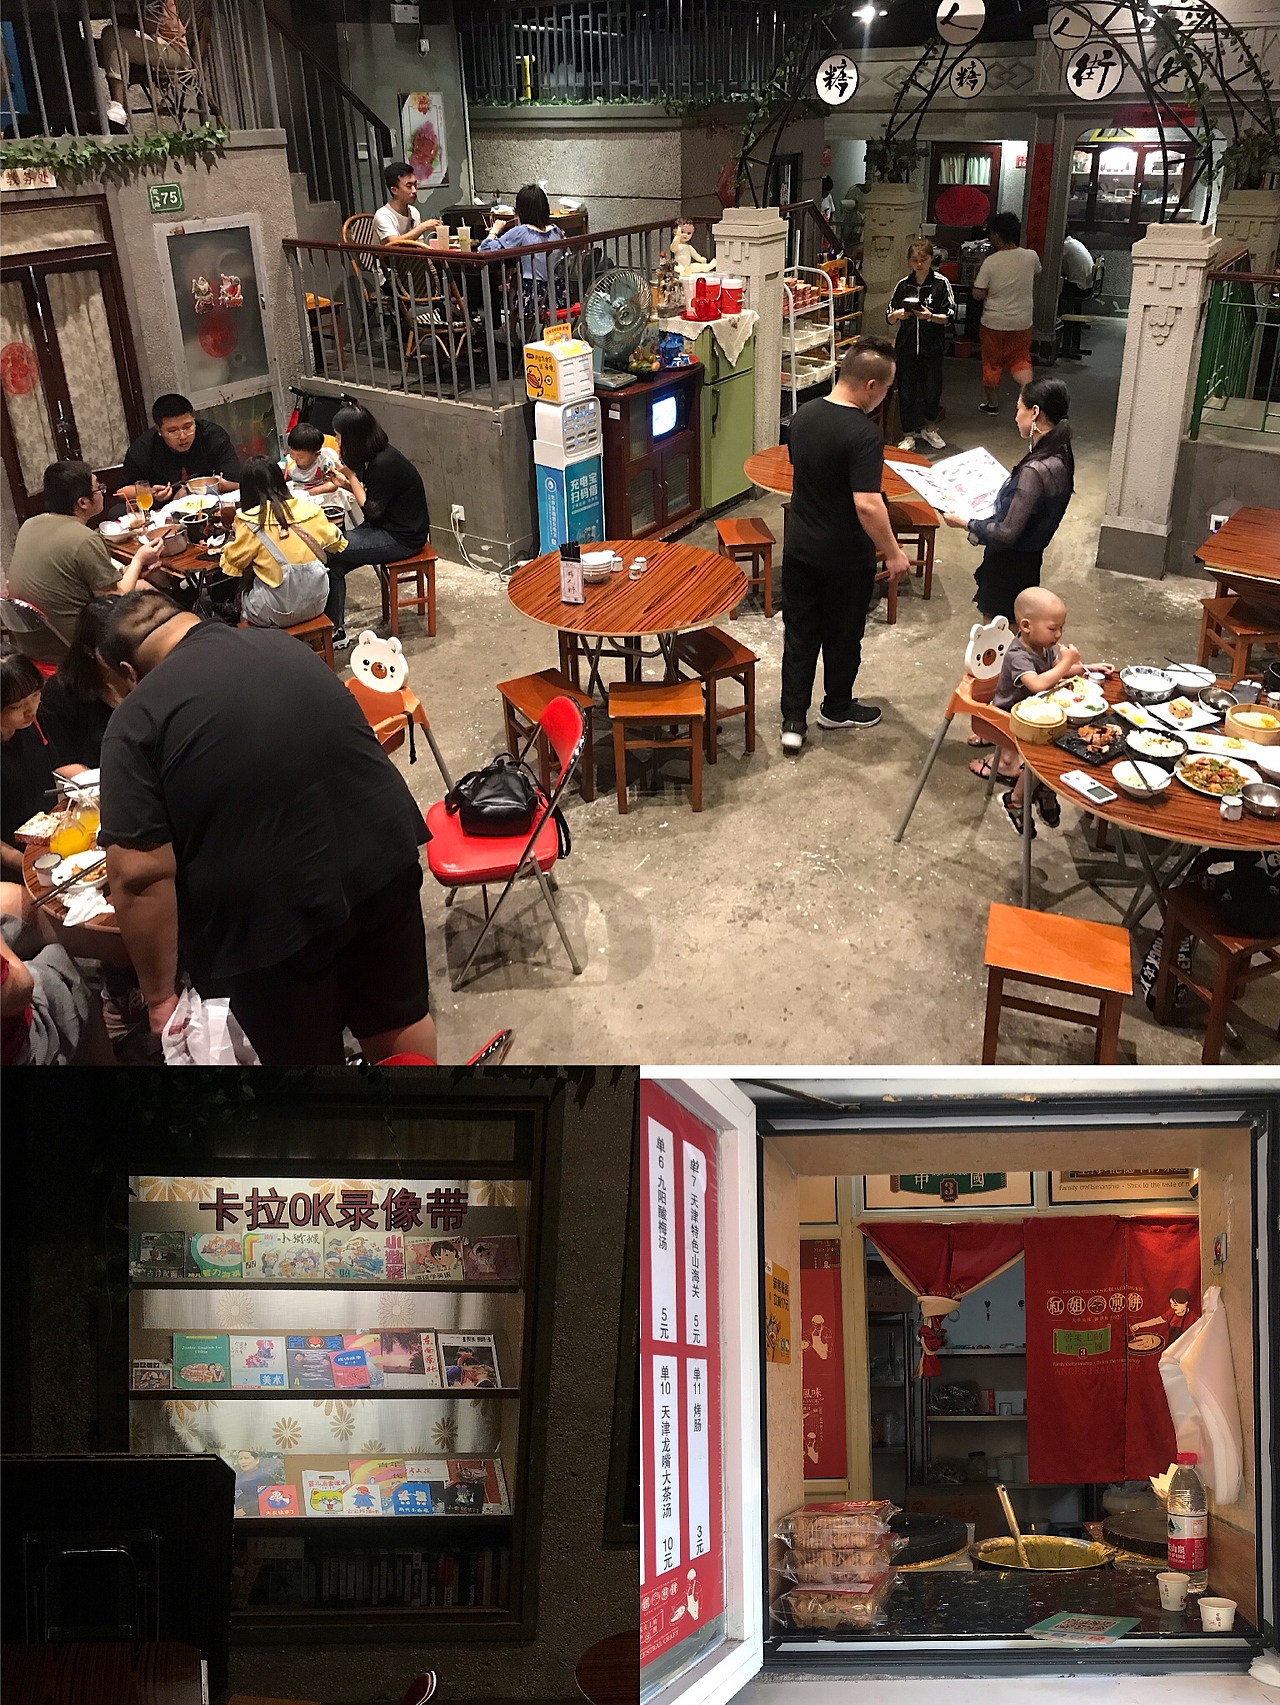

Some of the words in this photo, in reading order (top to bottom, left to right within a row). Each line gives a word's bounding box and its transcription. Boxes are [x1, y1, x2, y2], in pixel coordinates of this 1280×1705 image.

[940, 3, 978, 31] 人
[1053, 17, 1085, 39] 人
[1072, 49, 1118, 94] 街
[160, 191, 178, 205] 75
[570, 472, 597, 491] 充电宝
[571, 484, 598, 503] 扫码借
[944, 1181, 954, 1195] 3
[199, 1187, 469, 1231] 卡拉OK录像带
[656, 1174, 668, 1250] 九阳酸梅汤
[659, 1307, 669, 1340] 5元
[692, 1314, 701, 1344] 5元
[1080, 1348, 1086, 1356] 3
[263, 1374, 282, 1386] 美术
[693, 1402, 702, 1432] 烤肠
[661, 1404, 672, 1519] 天津龙嘴大茶汤
[662, 1536, 674, 1571] 10元
[696, 1525, 704, 1555] 3元
